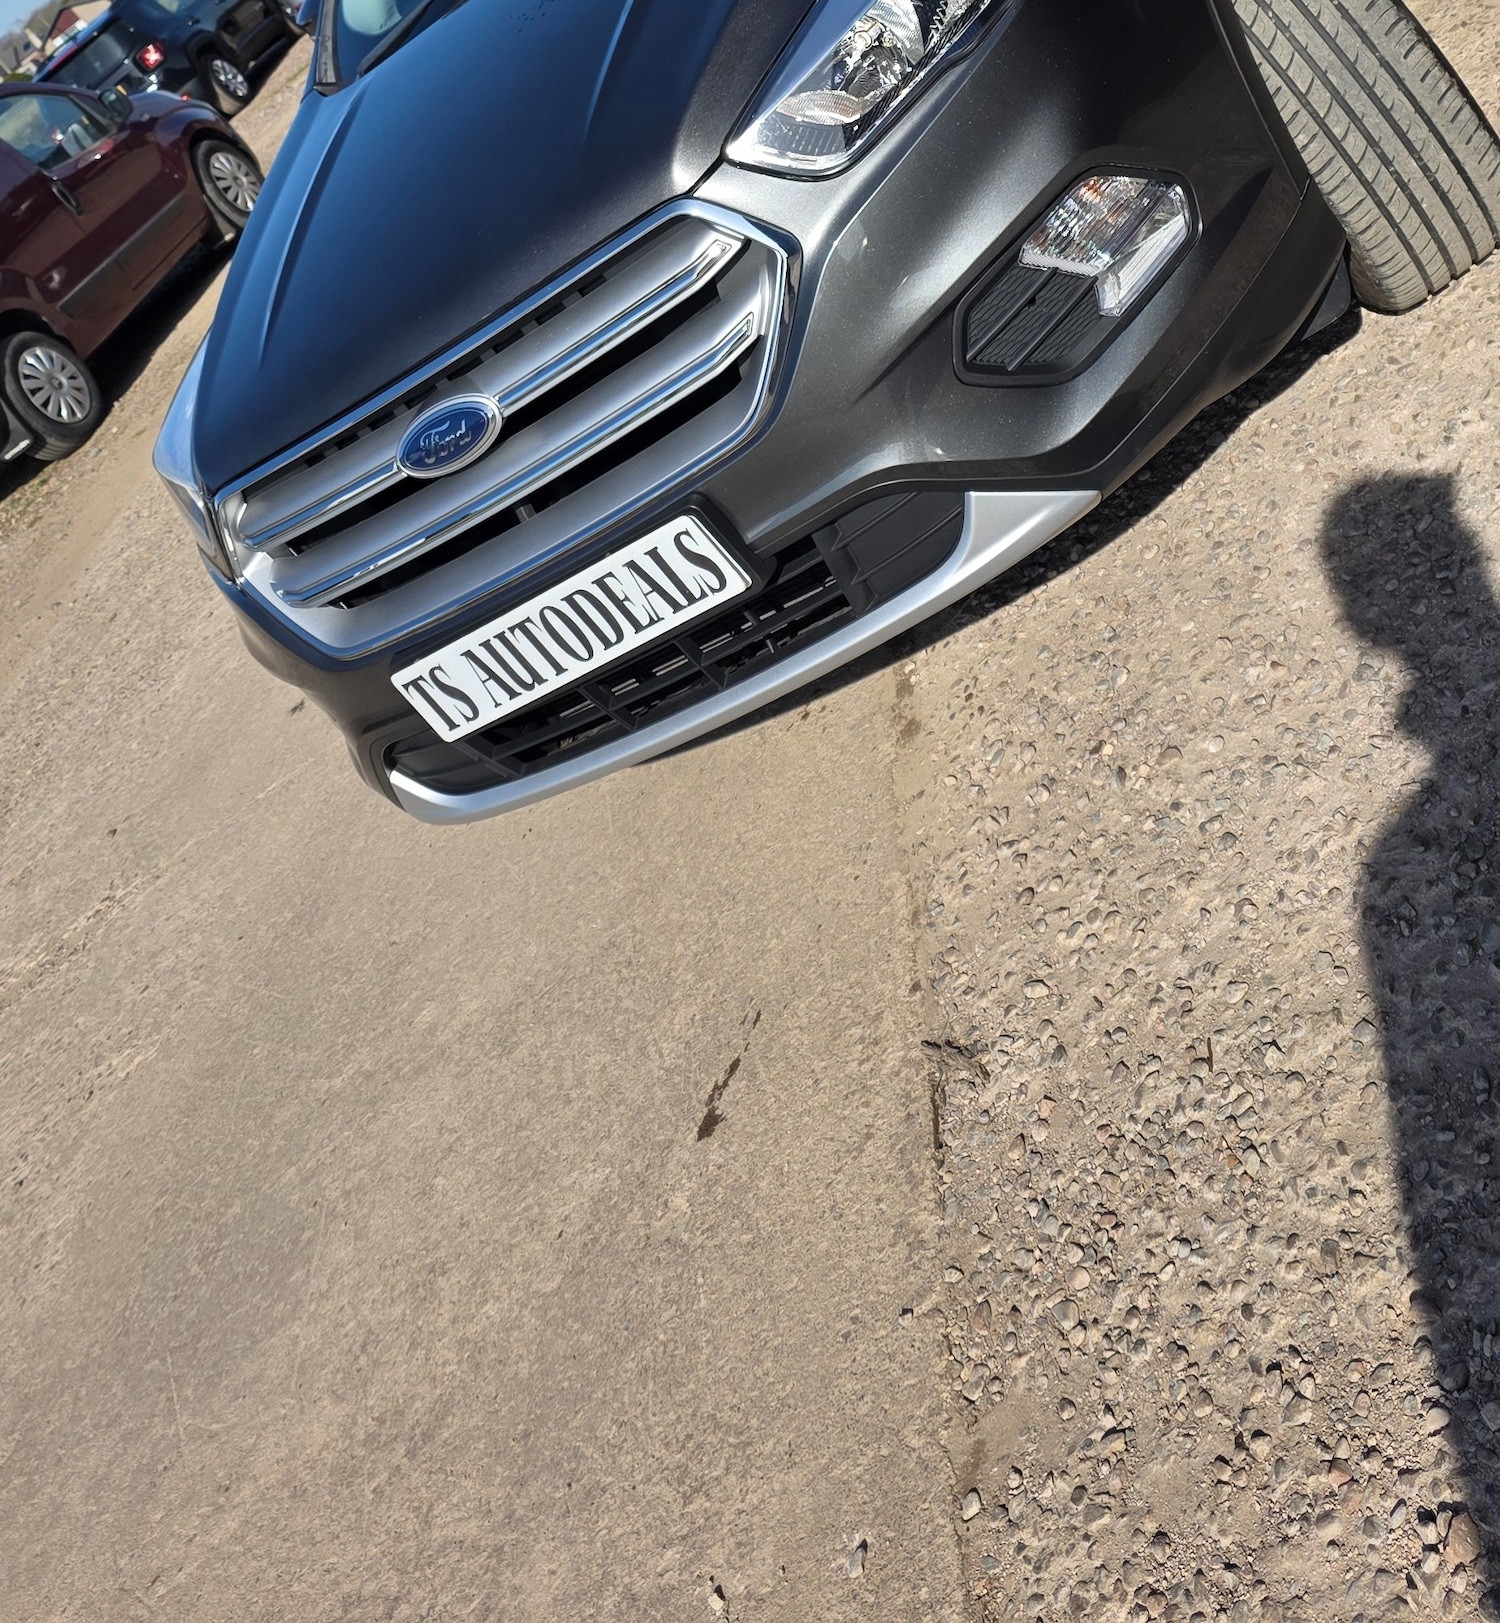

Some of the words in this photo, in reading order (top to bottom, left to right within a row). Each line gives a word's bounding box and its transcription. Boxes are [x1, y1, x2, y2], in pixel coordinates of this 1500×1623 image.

[419, 419, 472, 465] Ford
[403, 663, 480, 732] TS
[459, 527, 727, 708] AUTODEALS
